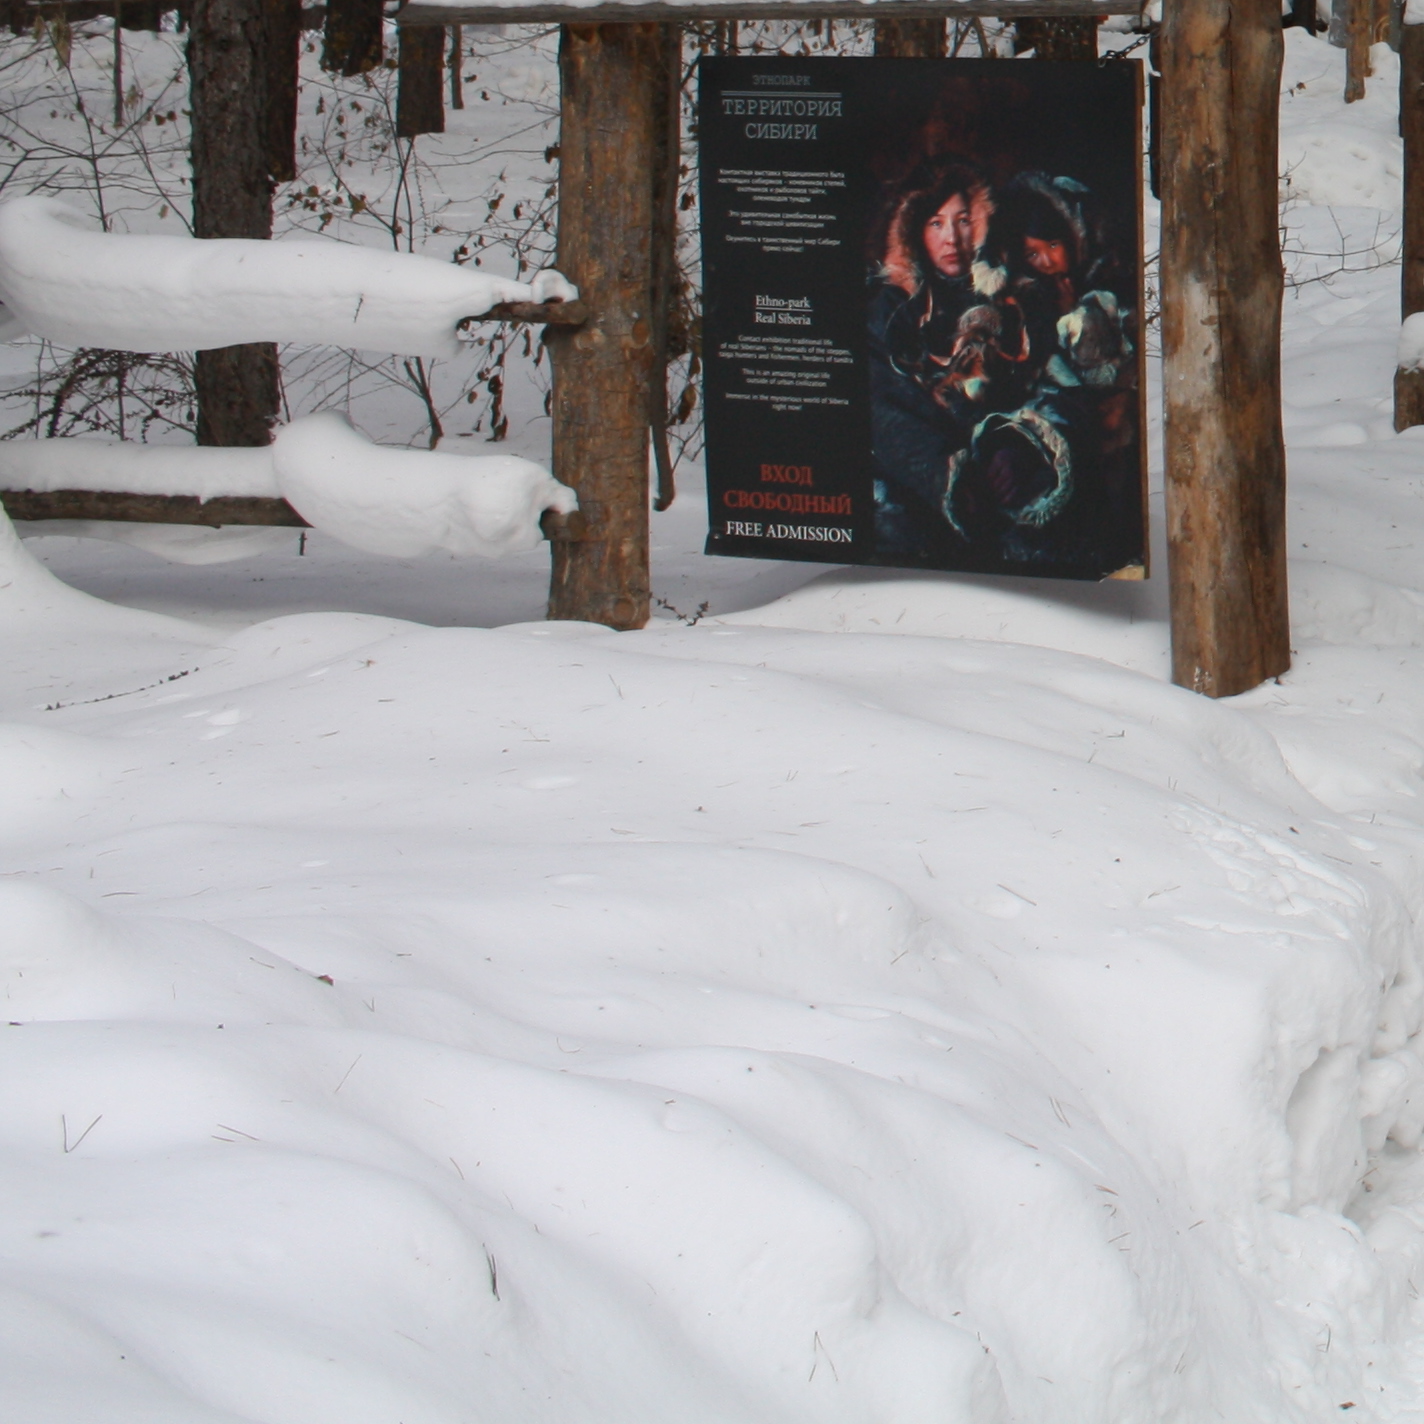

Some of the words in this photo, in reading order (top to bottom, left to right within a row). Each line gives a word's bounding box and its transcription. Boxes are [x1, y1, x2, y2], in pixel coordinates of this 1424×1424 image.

[752, 74, 811, 86] ЭТНОПАРК
[722, 99, 842, 116] ТЕРРИТОРИЯ
[745, 122, 817, 140] СИБИРИ
[755, 295, 811, 309] Ethno-park
[755, 312, 776, 323] Real
[778, 313, 812, 325] Siberia
[760, 464, 813, 486] ВХОД
[723, 489, 852, 515] СВОБОДНЫЙ
[726, 521, 763, 537] FREE
[766, 524, 853, 543] ADMISSION
